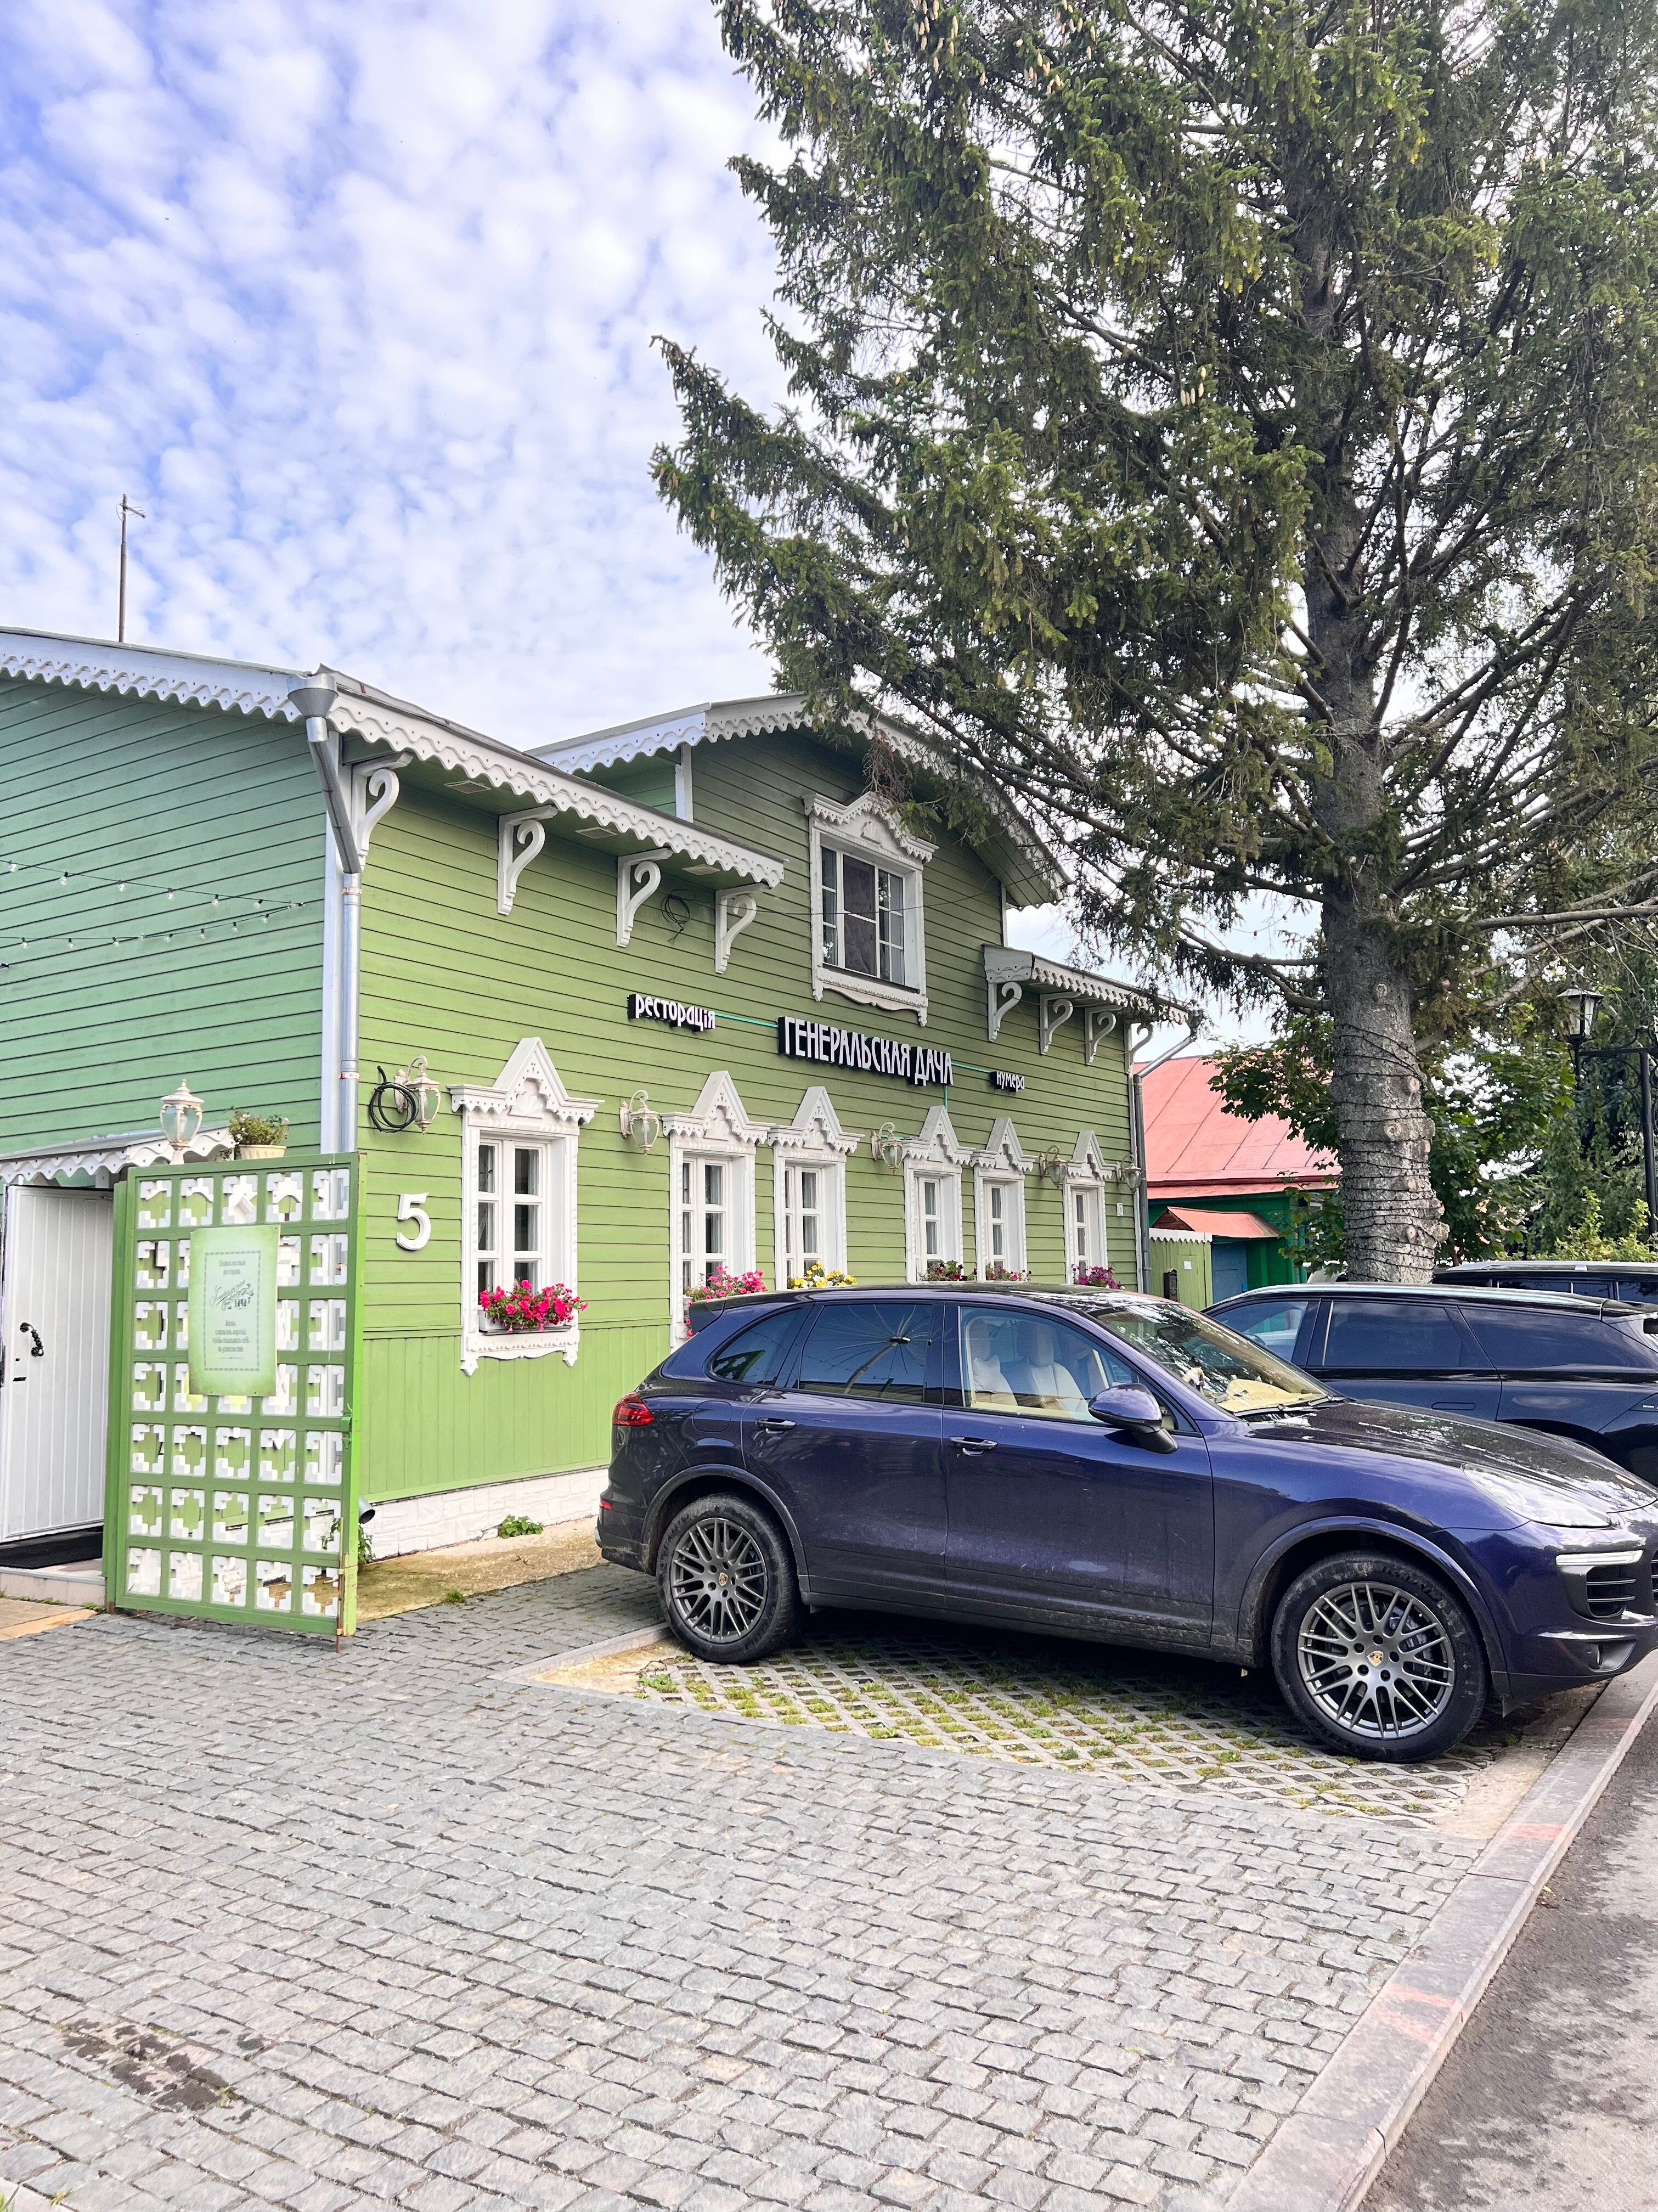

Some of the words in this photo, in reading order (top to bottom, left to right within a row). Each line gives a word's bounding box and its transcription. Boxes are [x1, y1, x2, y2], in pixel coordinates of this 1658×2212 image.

[785, 1016, 910, 1077] ГЕНЕРАЛЬСКАЯ
[915, 1046, 954, 1087] ДАЧА
[397, 1192, 431, 1250] 5
